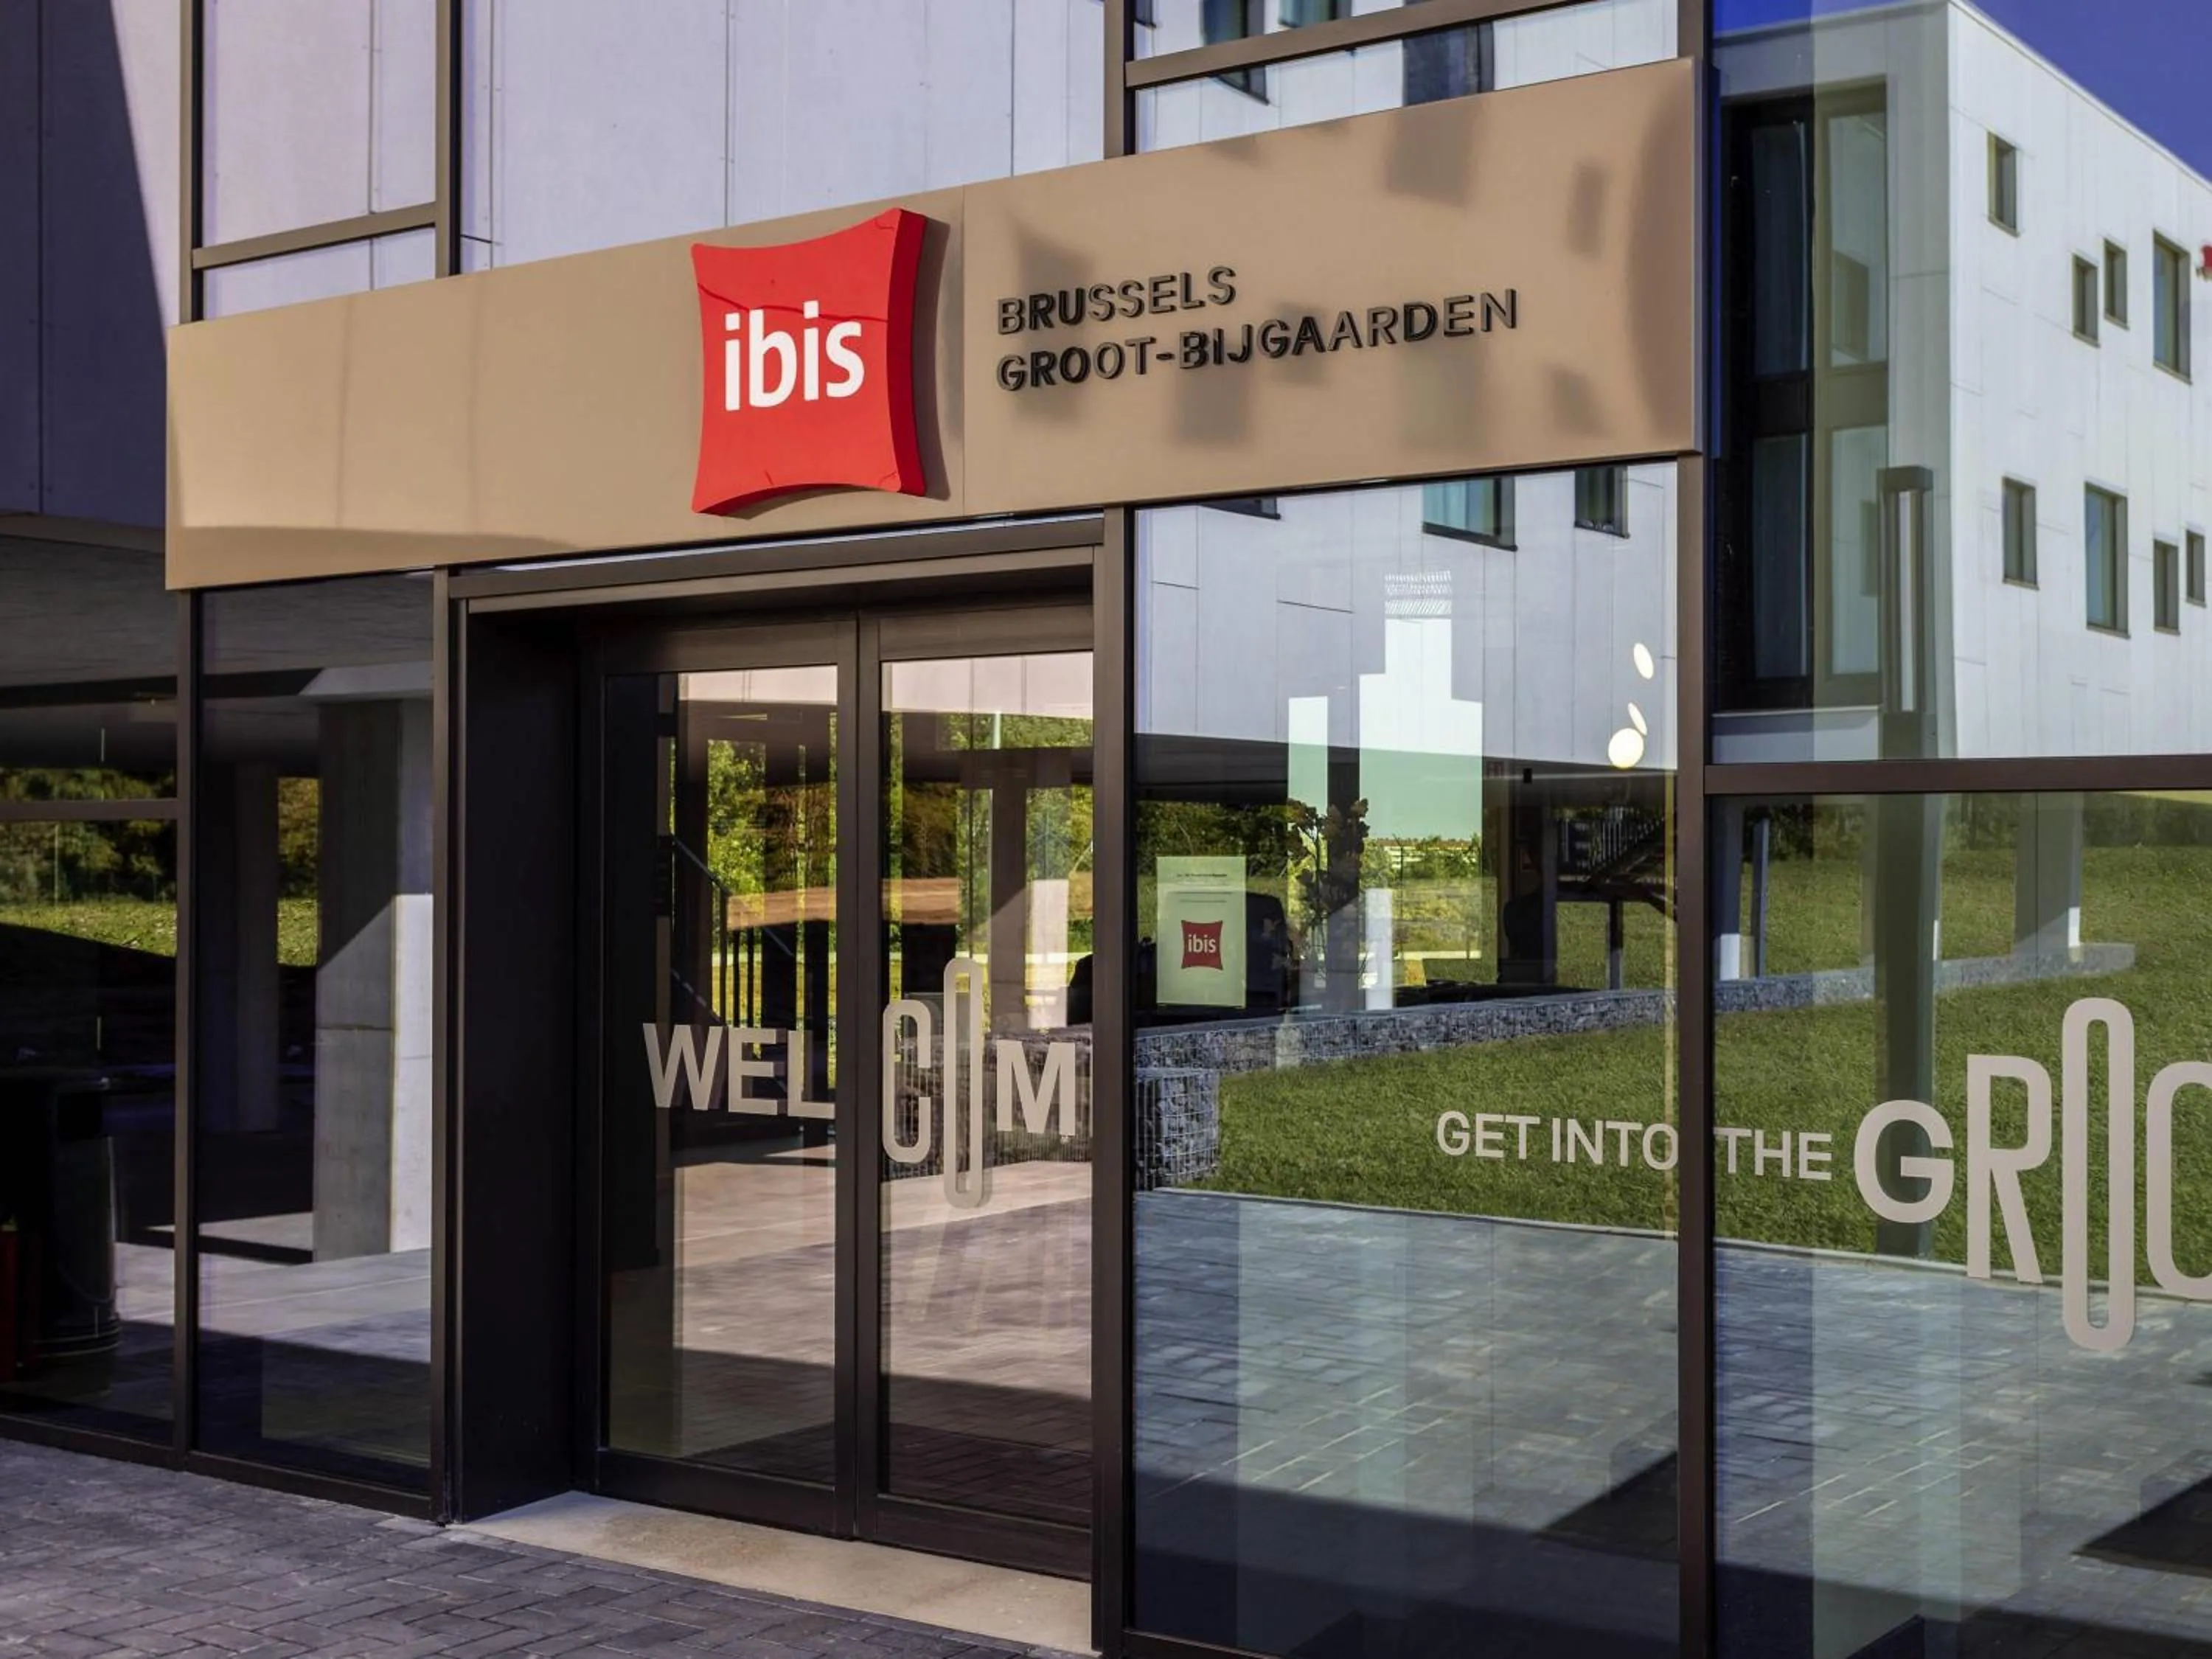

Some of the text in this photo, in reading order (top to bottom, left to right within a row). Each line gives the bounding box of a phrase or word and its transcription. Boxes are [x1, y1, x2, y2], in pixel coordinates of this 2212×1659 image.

[996, 288, 1517, 392] GROOT-BIJGAARDEN
[998, 266, 1237, 335] BRUSSELS
[725, 300, 865, 411] ibis
[1188, 934, 1217, 953] ibis
[643, 956, 1093, 1209] WELCOM
[1436, 1110, 1540, 1160] GET
[1552, 1118, 1679, 1170] INTO
[1714, 1127, 1833, 1180] THE
